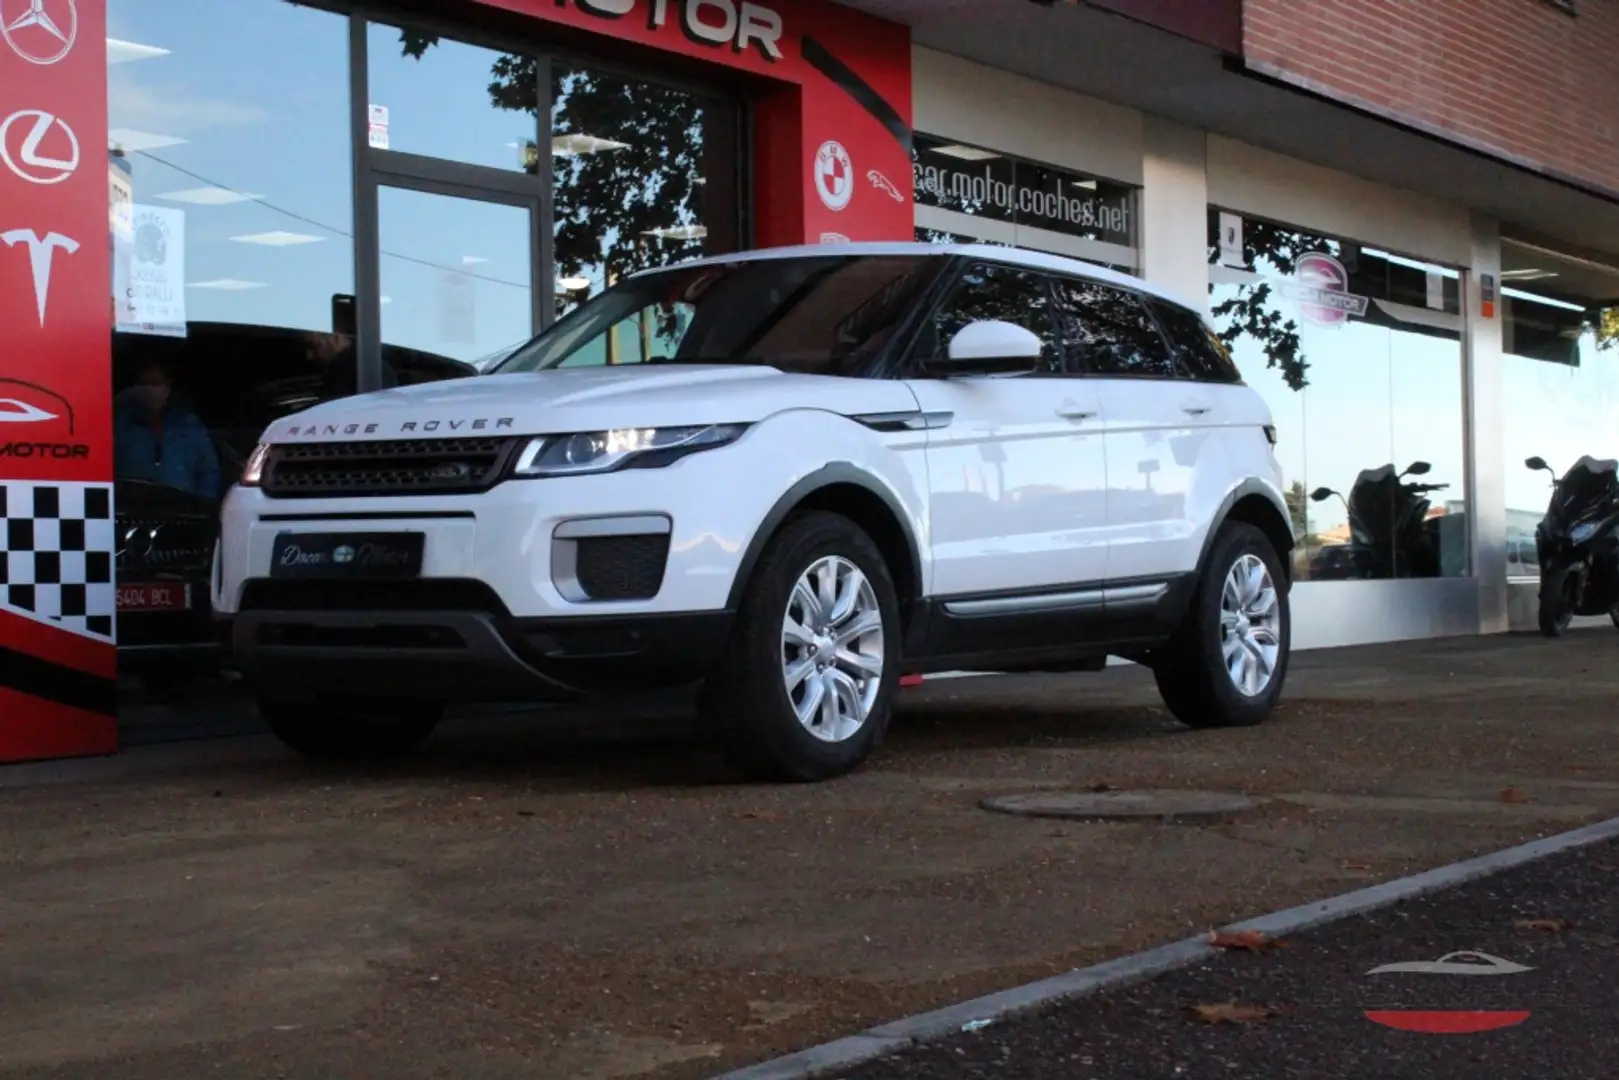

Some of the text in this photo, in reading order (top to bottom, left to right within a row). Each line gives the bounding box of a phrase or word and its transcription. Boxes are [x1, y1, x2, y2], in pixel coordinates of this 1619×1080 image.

[556, 0, 785, 59] TOR
[287, 416, 514, 437] RANGE ROVER
